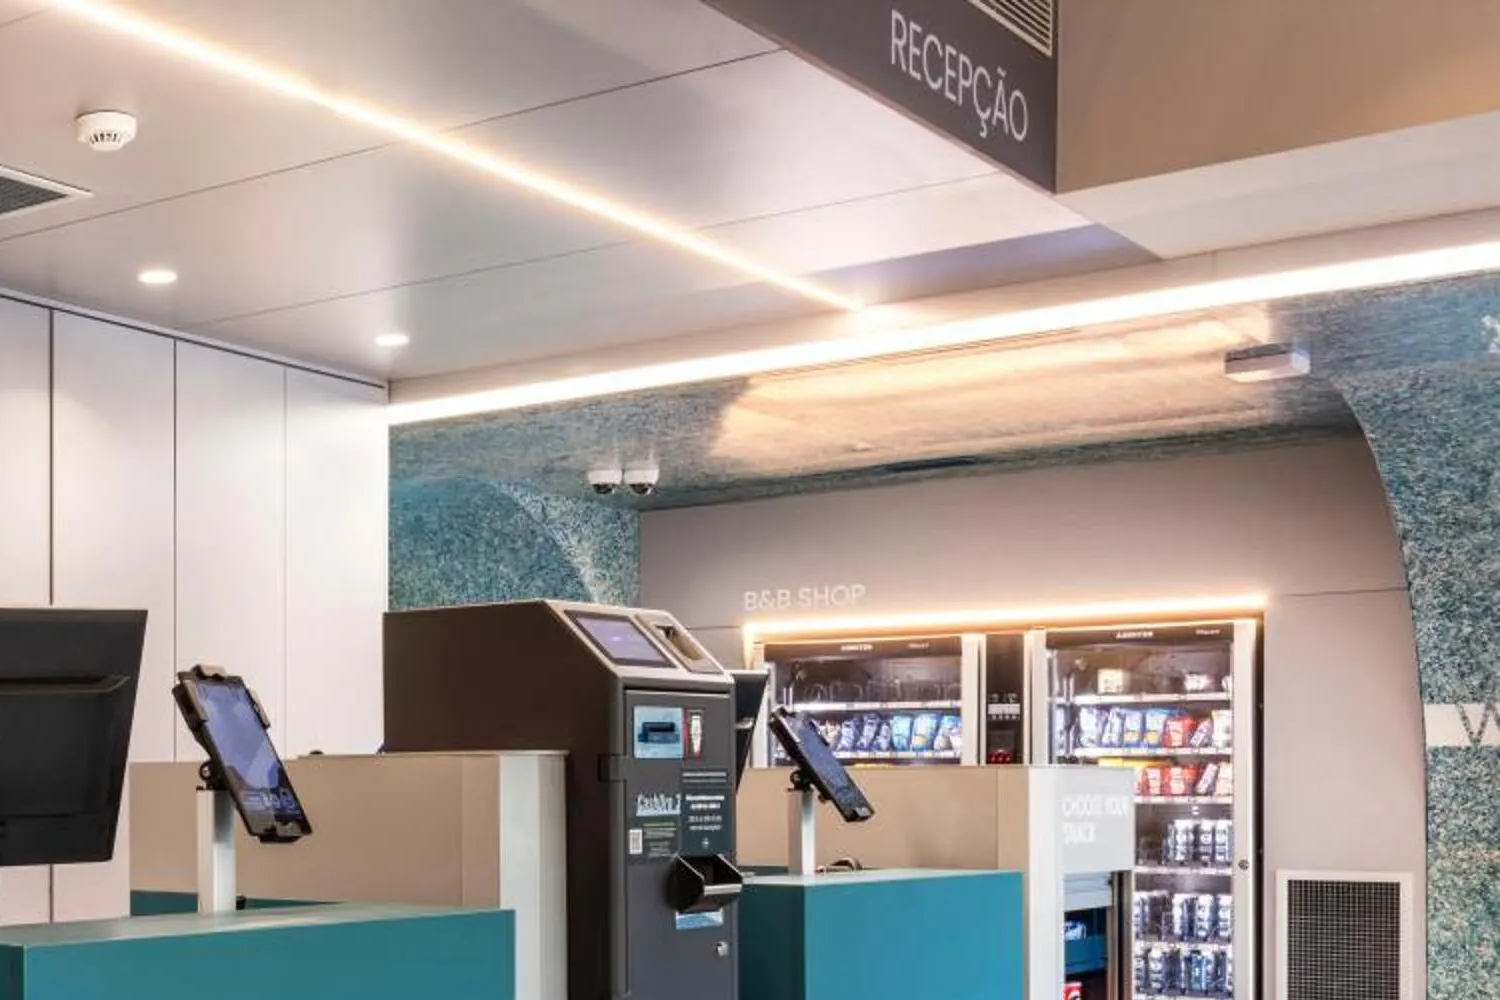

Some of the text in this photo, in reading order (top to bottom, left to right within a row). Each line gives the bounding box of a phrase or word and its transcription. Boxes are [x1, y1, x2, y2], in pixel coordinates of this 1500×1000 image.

[890, 9, 1028, 142] RECEPÇÃO
[744, 584, 866, 611] B&B SHOP
